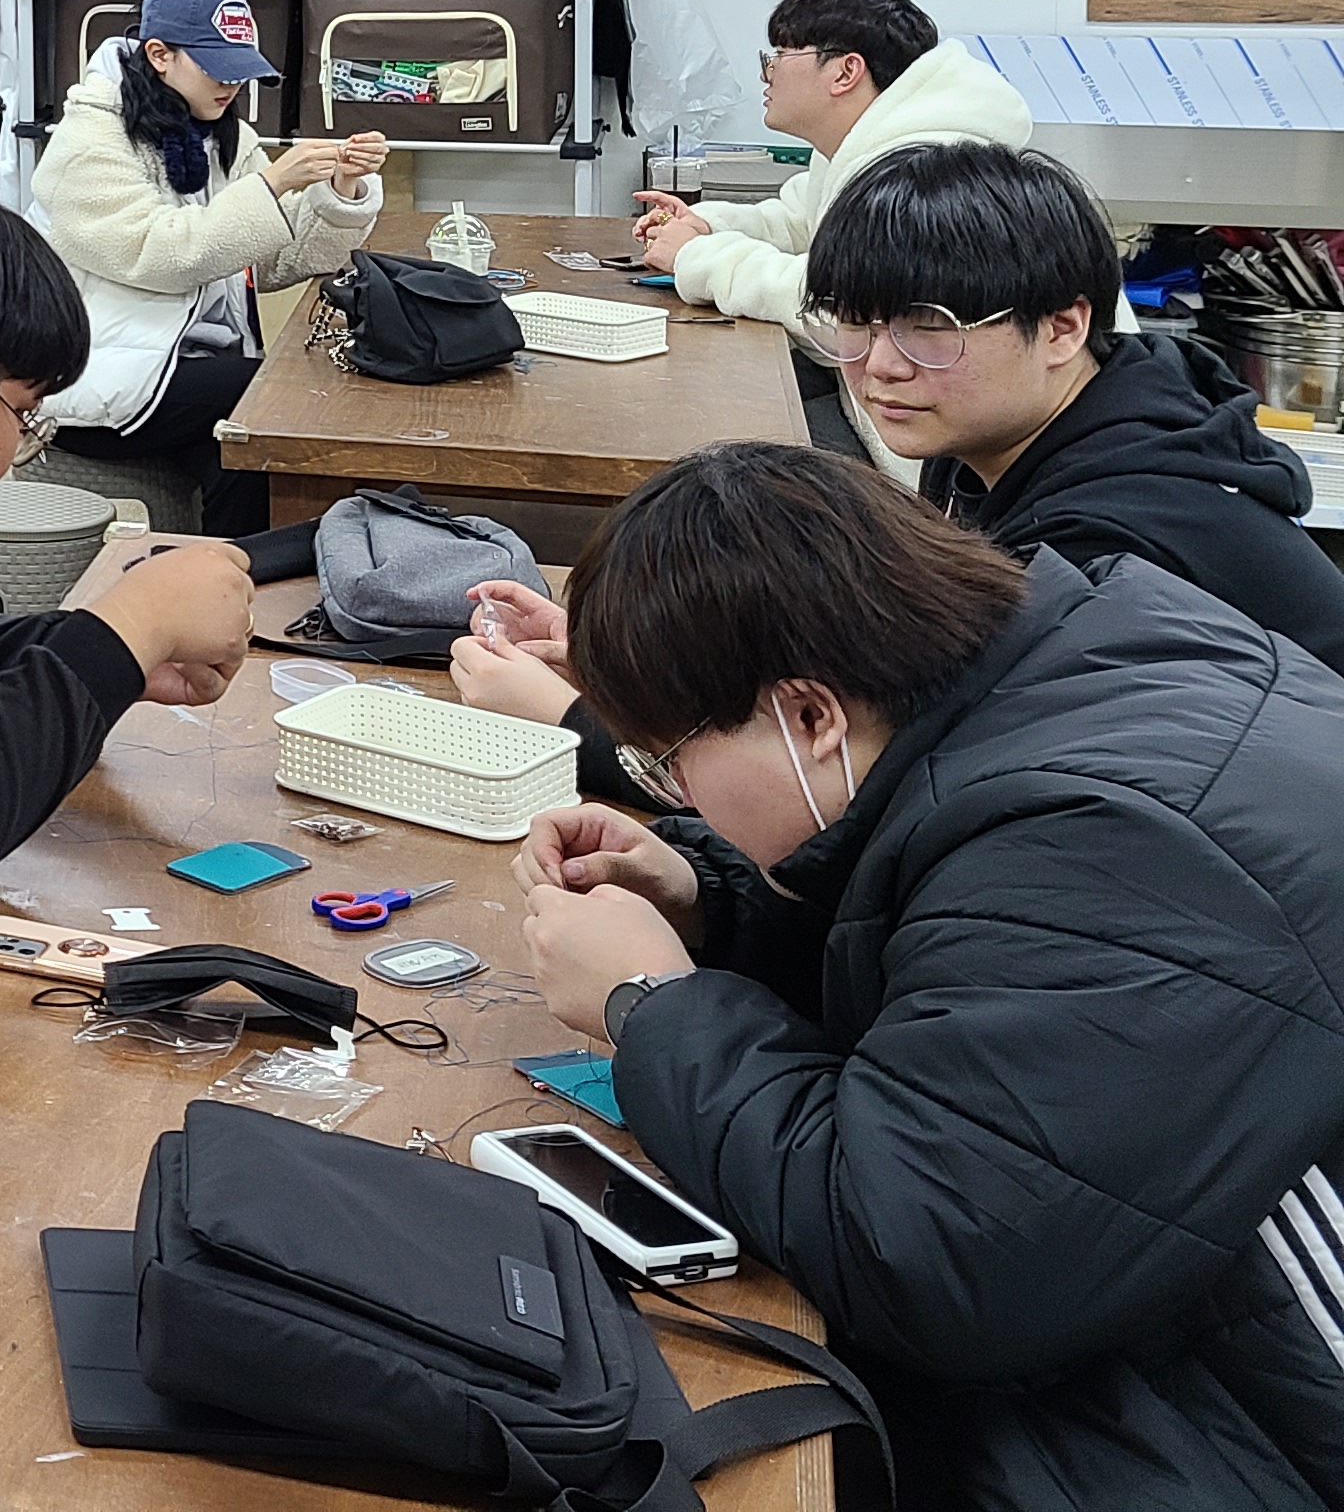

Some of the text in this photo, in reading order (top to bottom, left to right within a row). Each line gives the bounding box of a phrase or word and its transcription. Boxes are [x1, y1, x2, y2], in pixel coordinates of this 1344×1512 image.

[1080, 74, 1112, 115] STAINLESS
[1166, 75, 1199, 117] STAINLESS
[1254, 77, 1286, 119] STAINLESS
